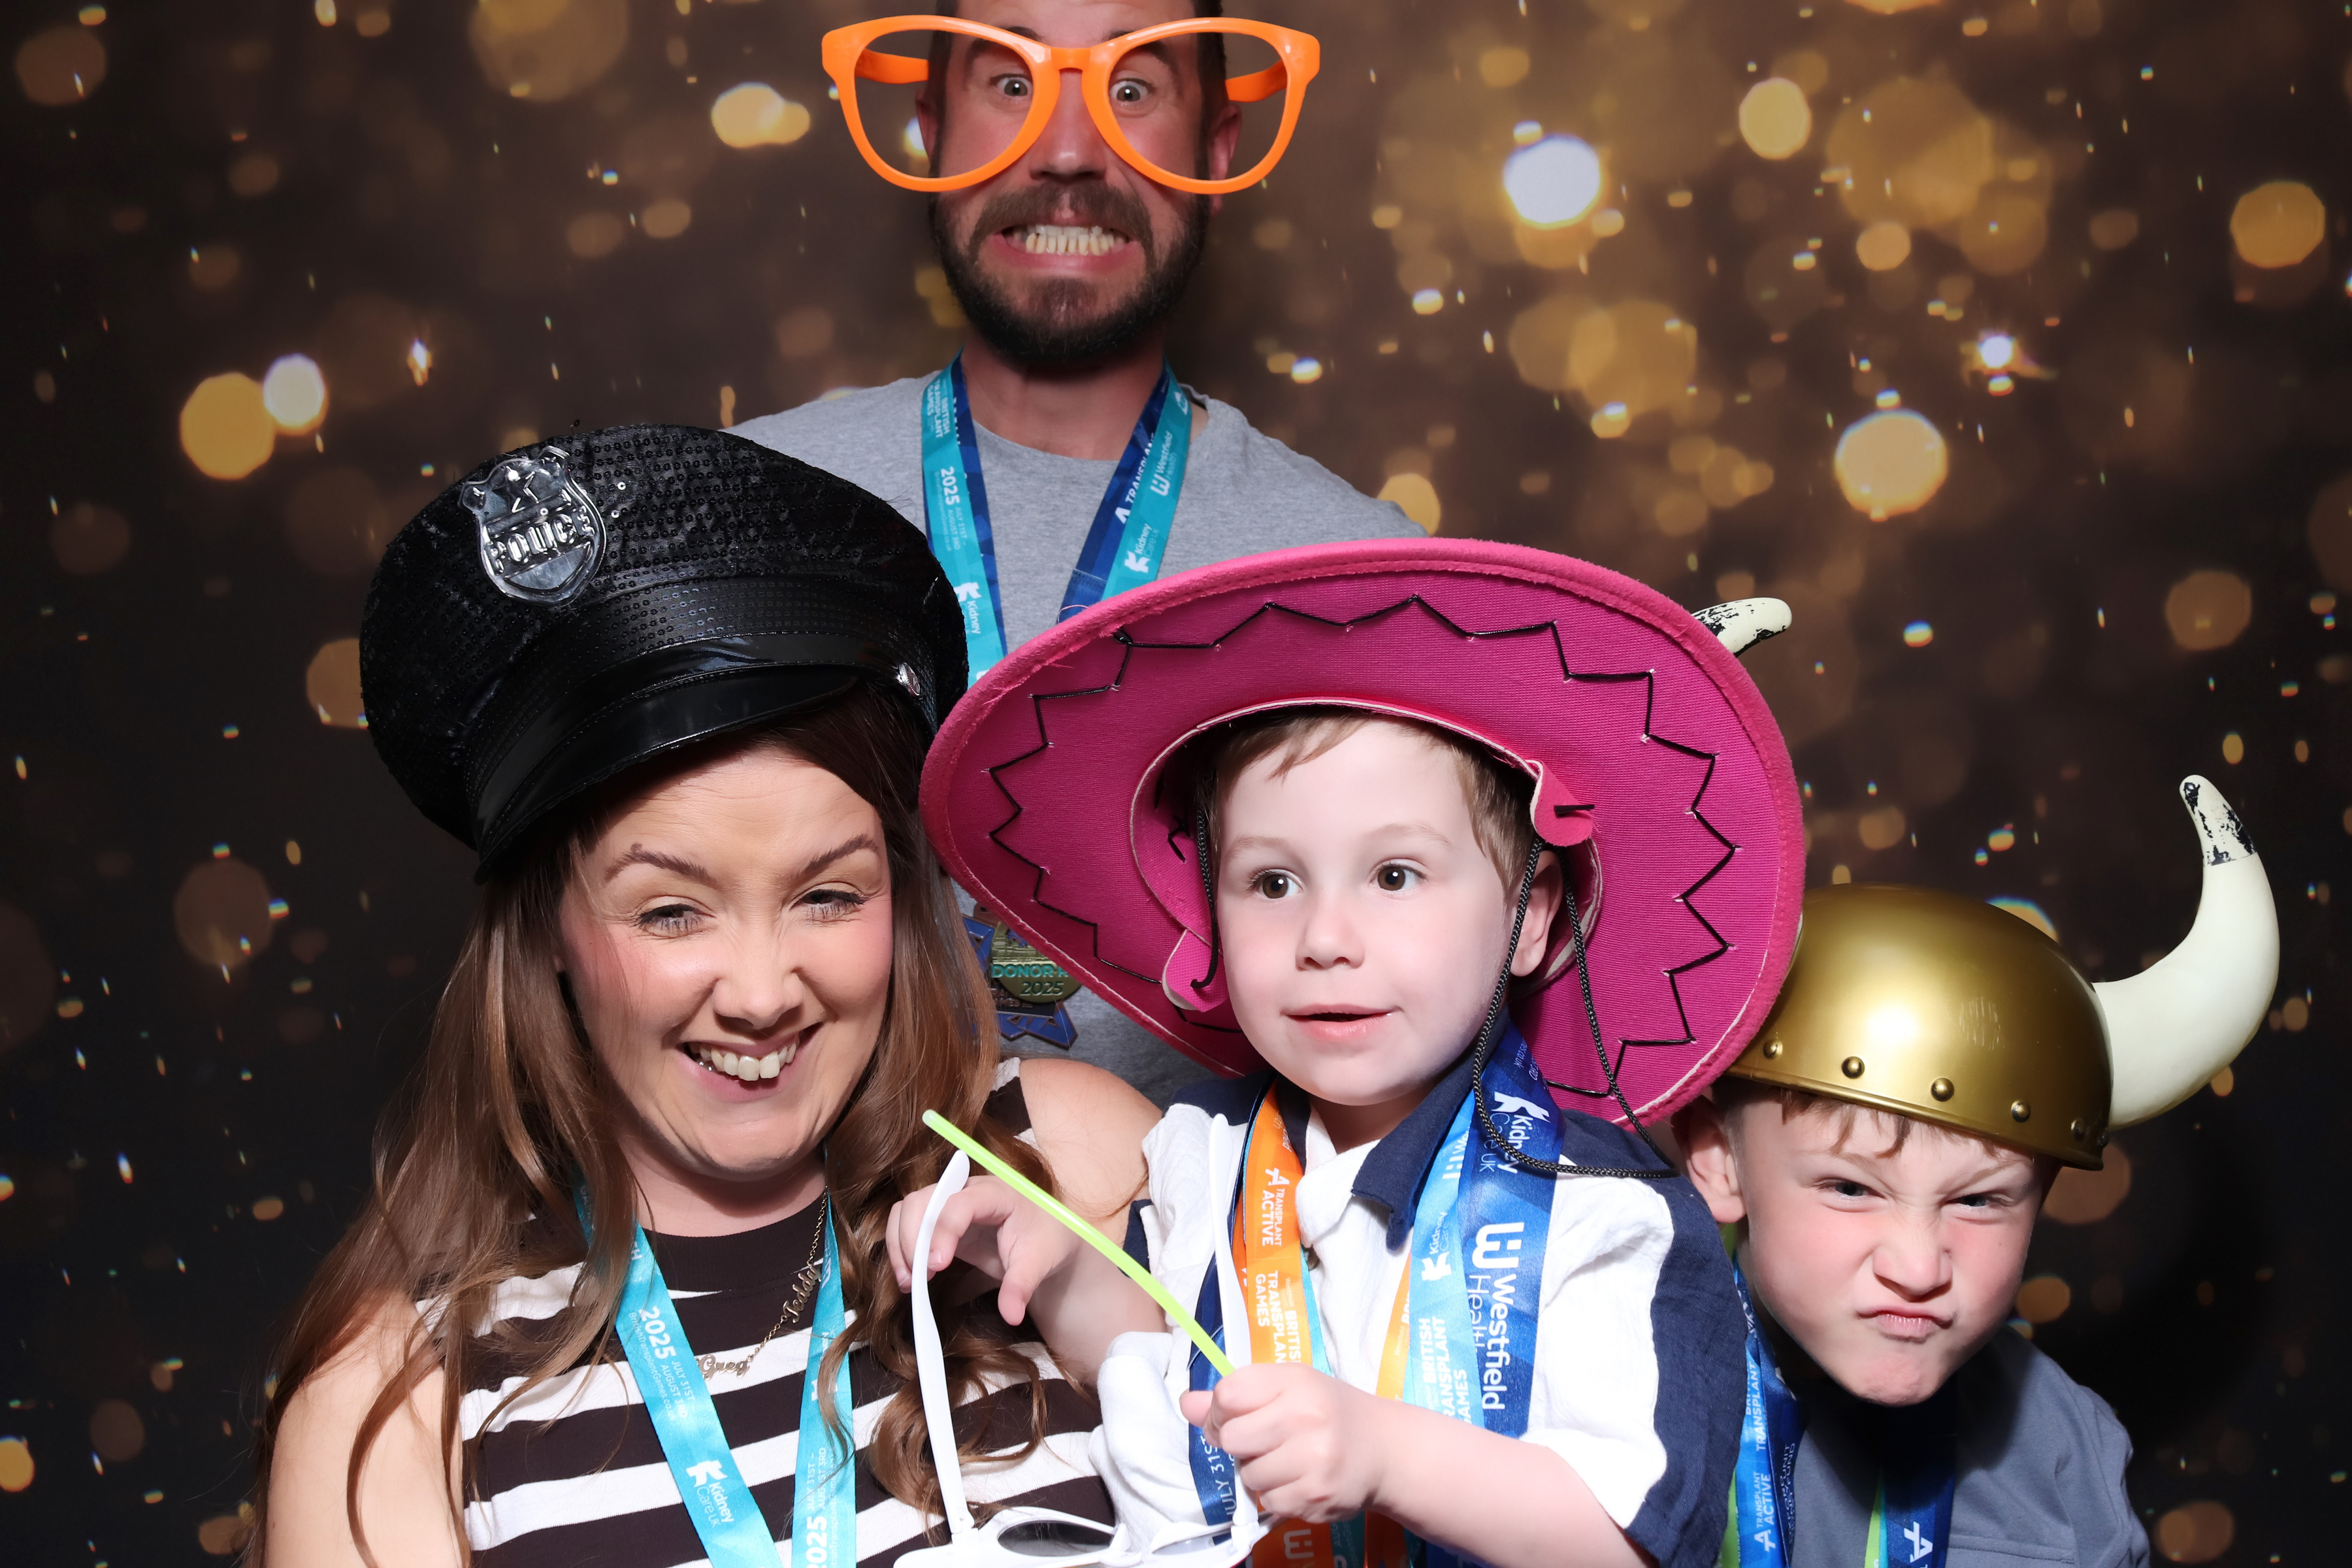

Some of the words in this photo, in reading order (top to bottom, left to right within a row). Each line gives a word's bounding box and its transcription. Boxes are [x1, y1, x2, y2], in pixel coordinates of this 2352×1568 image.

[1156, 431, 1173, 474] Westfield
[941, 466, 960, 506] 2025
[1134, 523, 1152, 555] Kidney
[967, 600, 981, 634] Kidney
[992, 964, 1054, 978] DONOR
[1019, 981, 1065, 996] 2025
[1478, 1152, 1497, 1172] UK
[1262, 1190, 1275, 1247] ACTIVE
[1274, 1188, 1285, 1247] TRANSPLANT
[1255, 1273, 1271, 1328] GAMES
[1267, 1269, 1287, 1364] TRANSPLAN
[638, 1306, 677, 1360] 2025
[1284, 1309, 1301, 1364] BRITIS
[1418, 1318, 1437, 1384] BRITISH
[1482, 1274, 1517, 1411] Westfield
[661, 1364, 681, 1397] AUGUST
[675, 1399, 688, 1418] 3RD
[671, 1360, 686, 1379] JULY
[680, 1380, 695, 1401] 31ST
[1432, 1316, 1456, 1417] RANSPLANT
[1454, 1369, 1473, 1425] AMES
[807, 1462, 815, 1485] 31ST
[1753, 1471, 1764, 1528] TRANSPLANT
[1761, 1473, 1774, 1526] ACTIVE
[696, 1486, 715, 1514] Care
[708, 1512, 721, 1528] UK
[708, 1482, 735, 1523] Kidney
[806, 1488, 815, 1512] JULY
[806, 1516, 827, 1568] 025
